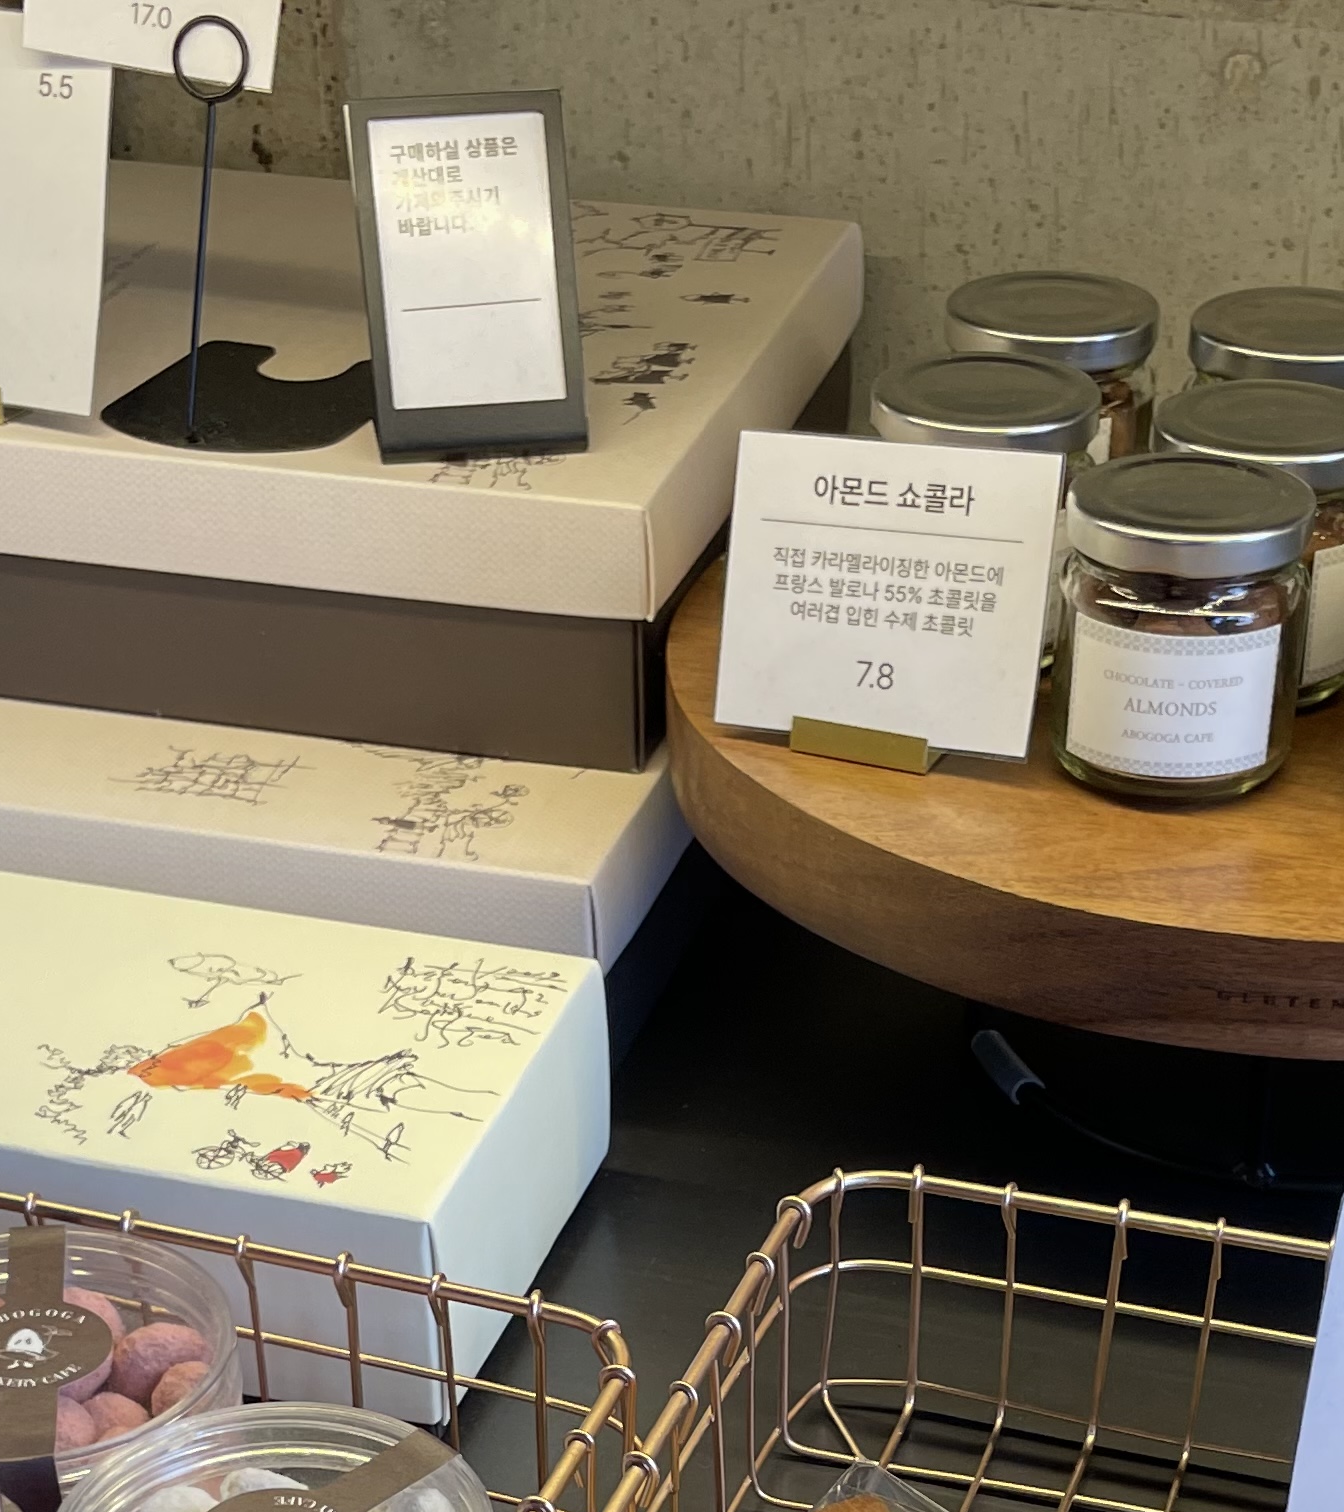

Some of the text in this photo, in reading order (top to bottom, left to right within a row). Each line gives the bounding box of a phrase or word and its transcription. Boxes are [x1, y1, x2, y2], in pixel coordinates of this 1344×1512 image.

[130, 2, 173, 29] 17.0
[38, 73, 73, 100] 5.5
[389, 136, 518, 164] 구매하실 상품은
[398, 215, 475, 237] 바랍니다.
[814, 475, 975, 516] 아몬드 쇼콜라
[772, 547, 1004, 586] 직접 카라멜라이징한 아몬드에
[772, 573, 997, 613] 프랑스 발로나 55% 초콜릿을
[790, 601, 974, 637] 여러겹 입힌 수제 초콜릿
[856, 660, 895, 690] 7.8
[1103, 668, 1244, 691] CHOCOLATE COVERED
[1123, 697, 1218, 718] ALMONDS
[1121, 728, 1214, 744] ABOGOGA CAFE
